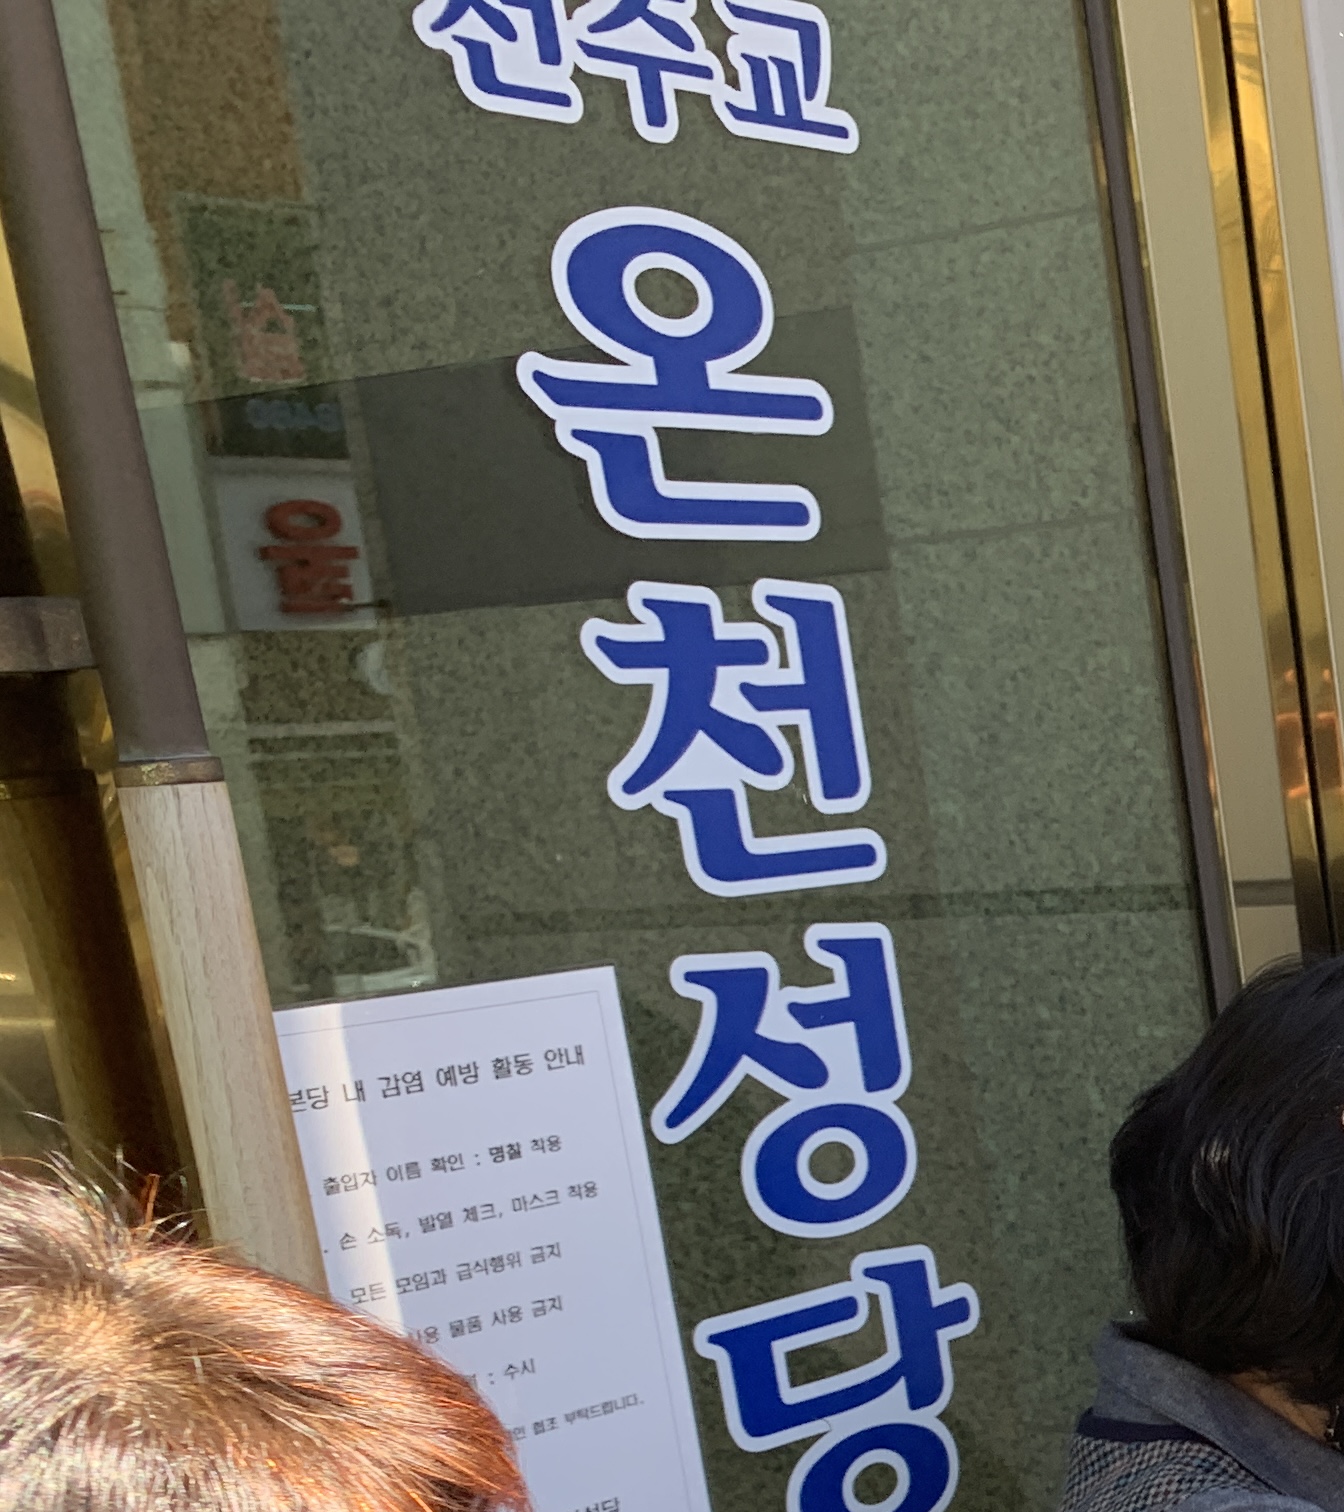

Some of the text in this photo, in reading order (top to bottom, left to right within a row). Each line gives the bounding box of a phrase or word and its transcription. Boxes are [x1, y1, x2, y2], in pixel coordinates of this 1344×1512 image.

[342, 1079, 367, 1104] 내
[378, 1070, 425, 1099] 감염
[436, 1061, 480, 1088] 예방
[491, 1053, 534, 1081] 활동
[543, 1044, 586, 1072] 안내
[322, 1168, 378, 1197] 출입자
[385, 1160, 423, 1183] 이름
[429, 1152, 465, 1175] 확인
[488, 1141, 523, 1164] 명찰
[530, 1134, 563, 1154] 착용
[338, 1231, 358, 1252] 손
[418, 1210, 454, 1235] 발열
[462, 1202, 504, 1225] 체크,
[511, 1190, 562, 1214] 마스크
[567, 1180, 599, 1201] 착용
[350, 1241, 562, 1305] 모든 모임과 급식행위 금지
[448, 1314, 484, 1339] 물품
[491, 1305, 524, 1326] 사용
[531, 1295, 564, 1318] 금지
[503, 1357, 537, 1380] 수시
[532, 1416, 560, 1436] 협조
[564, 1392, 646, 1425] 부탁드립니다.
